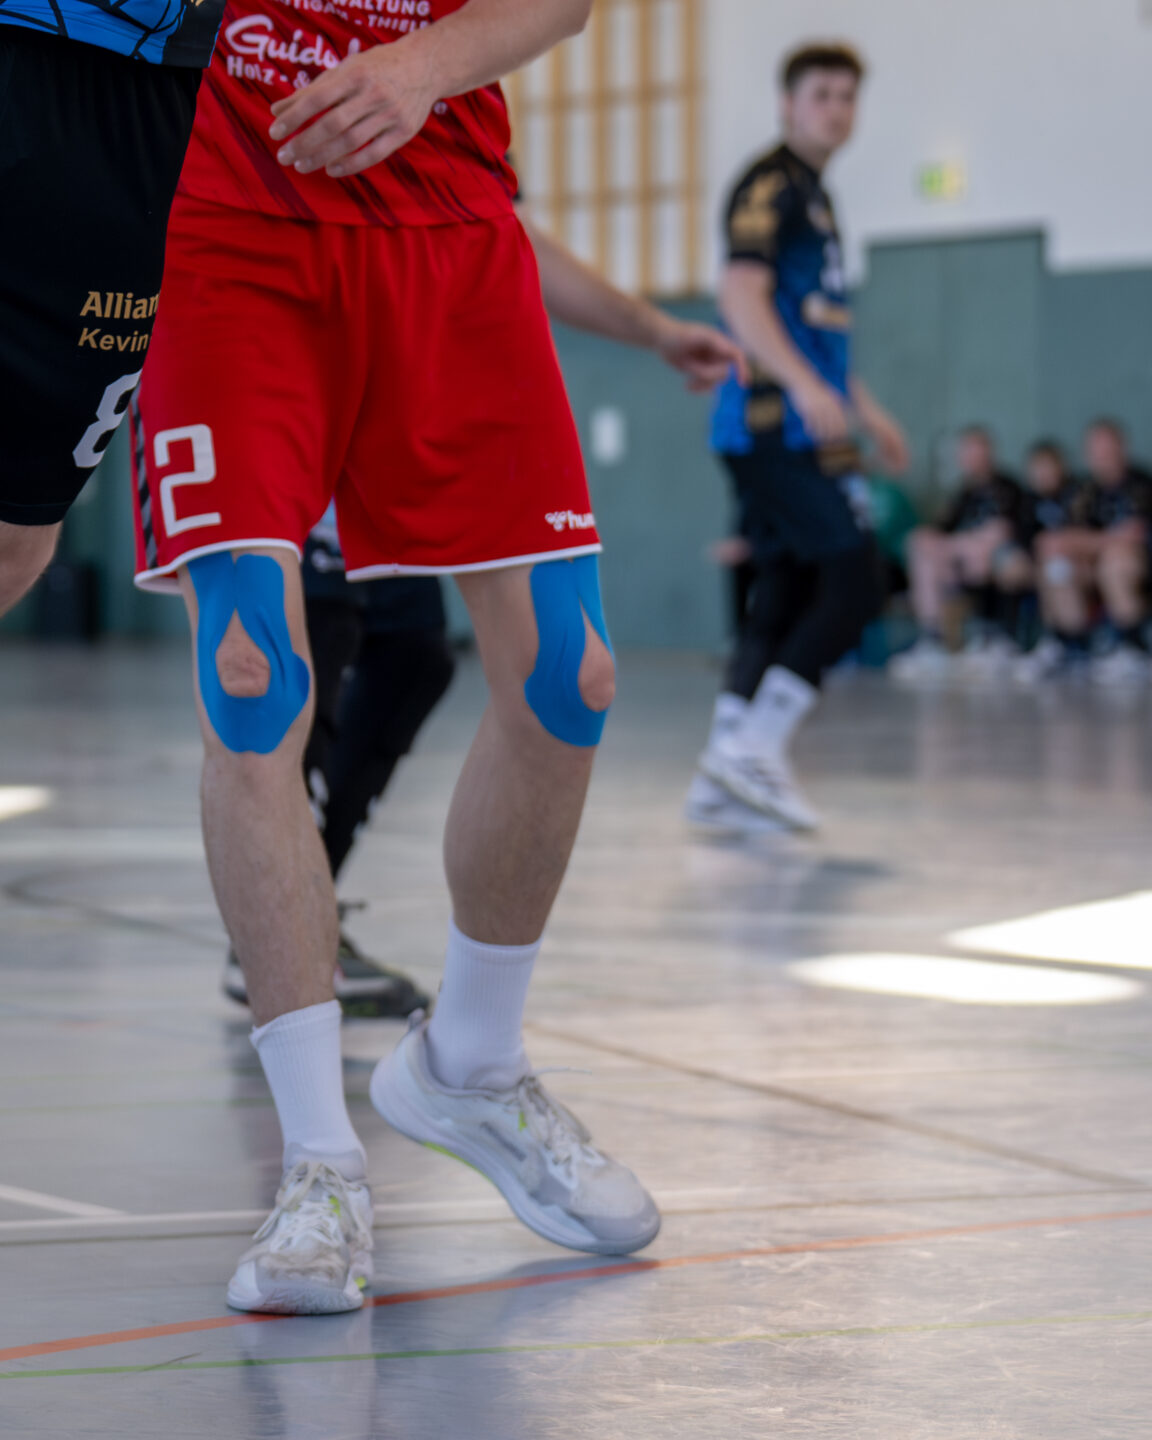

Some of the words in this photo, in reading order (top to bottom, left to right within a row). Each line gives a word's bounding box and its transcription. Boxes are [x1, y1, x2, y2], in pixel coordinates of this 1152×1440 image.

[79, 290, 160, 320] Allian
[77, 326, 148, 353] Kevin
[153, 423, 222, 539] 2
